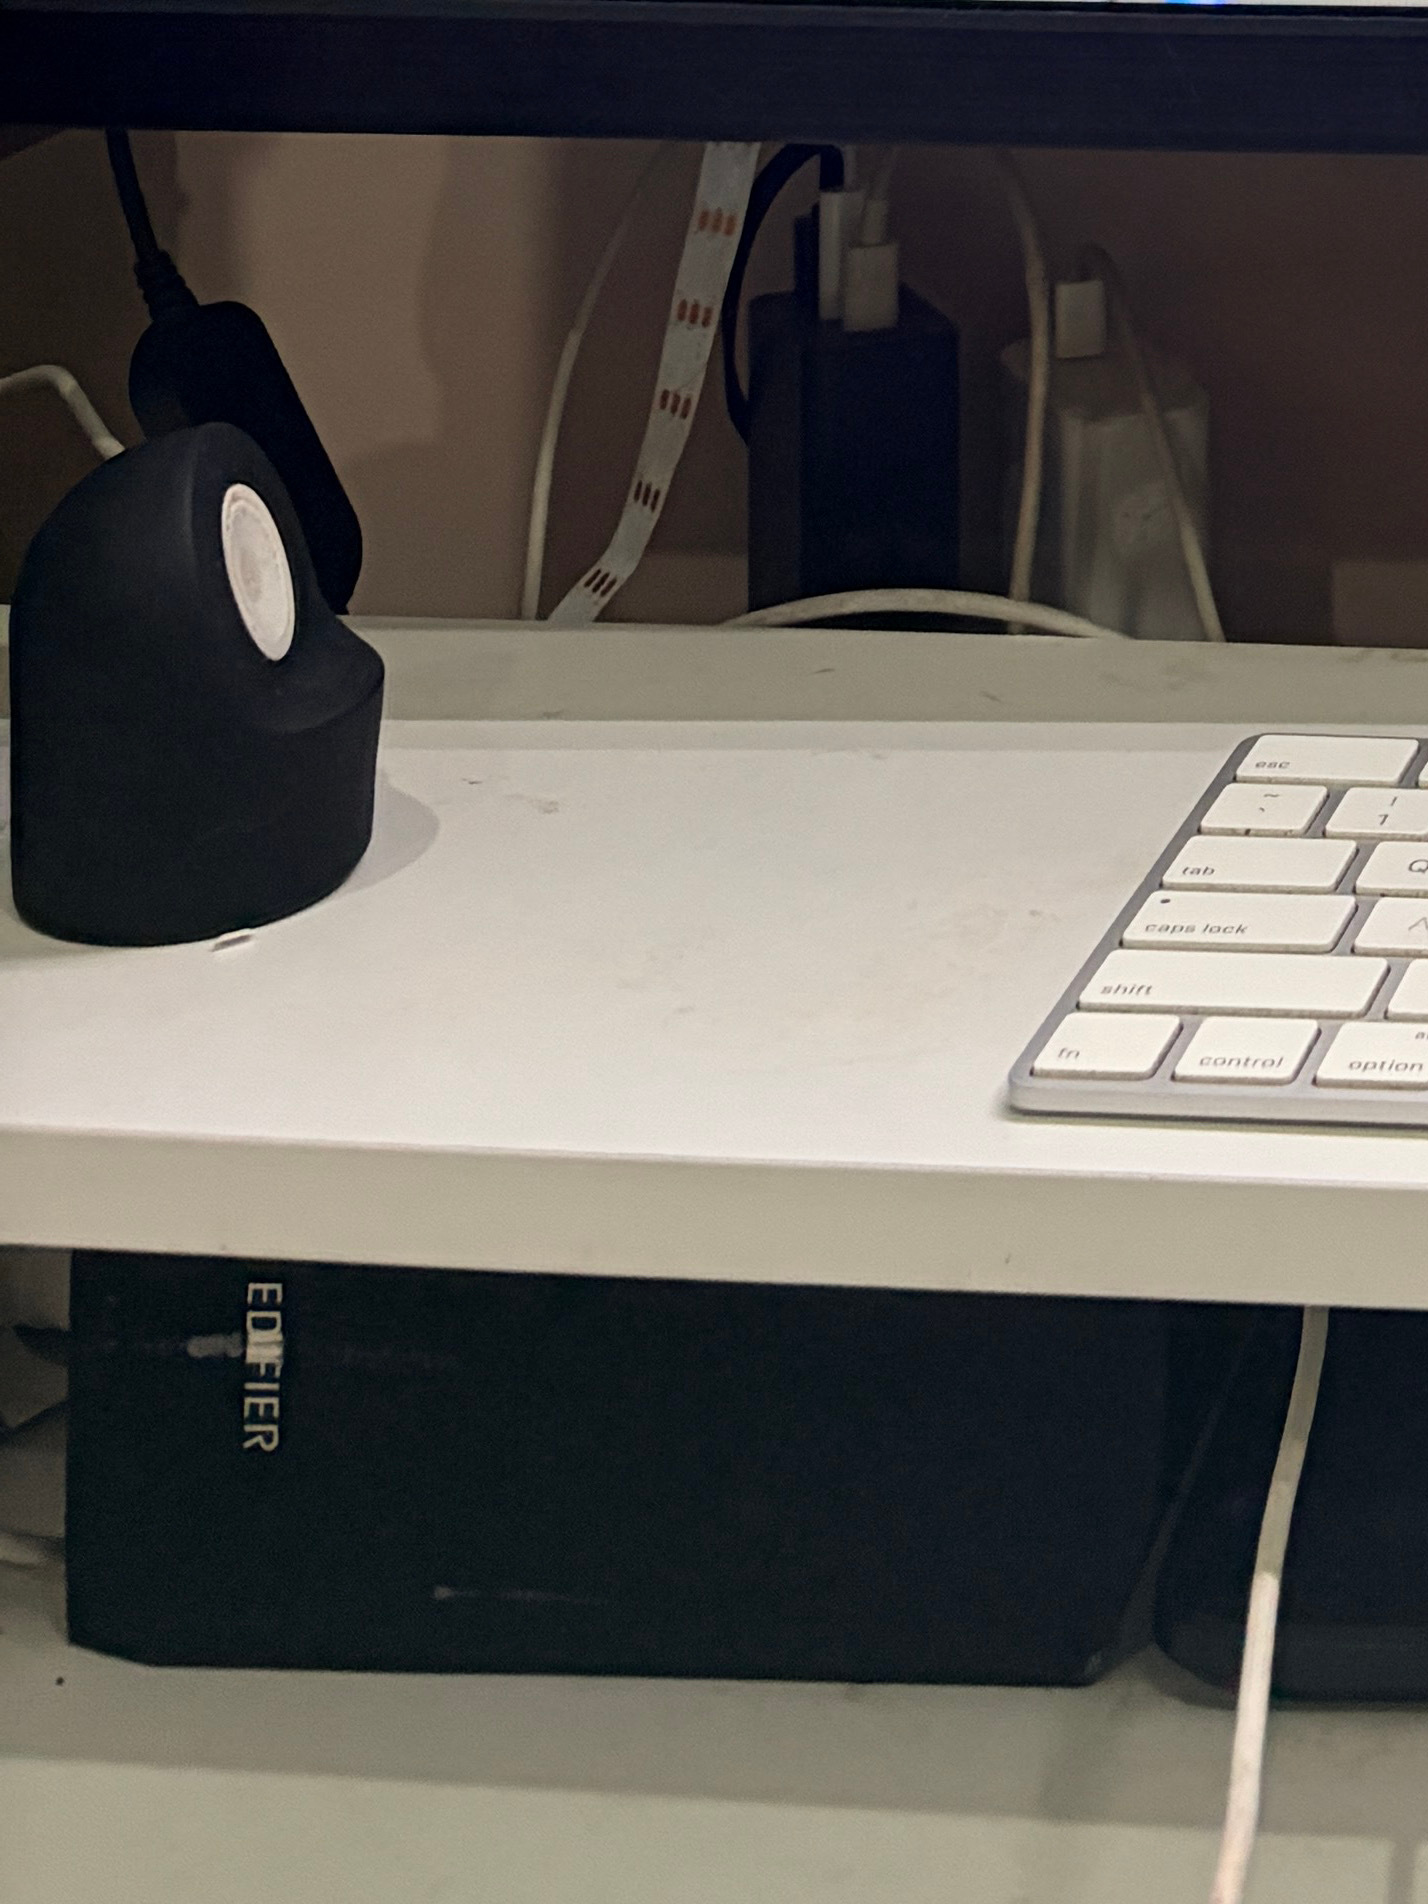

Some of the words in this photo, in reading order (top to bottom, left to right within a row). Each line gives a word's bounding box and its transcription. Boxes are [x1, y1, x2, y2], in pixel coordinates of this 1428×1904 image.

[1378, 813, 1389, 826] 1
[1182, 866, 1215, 876] tab
[1145, 924, 1196, 935] caps
[1202, 923, 1248, 934] lock
[1100, 983, 1153, 996] shift
[1199, 1056, 1284, 1069] control
[1348, 1059, 1424, 1073] option
[242, 1281, 285, 1453] EDIFIER
